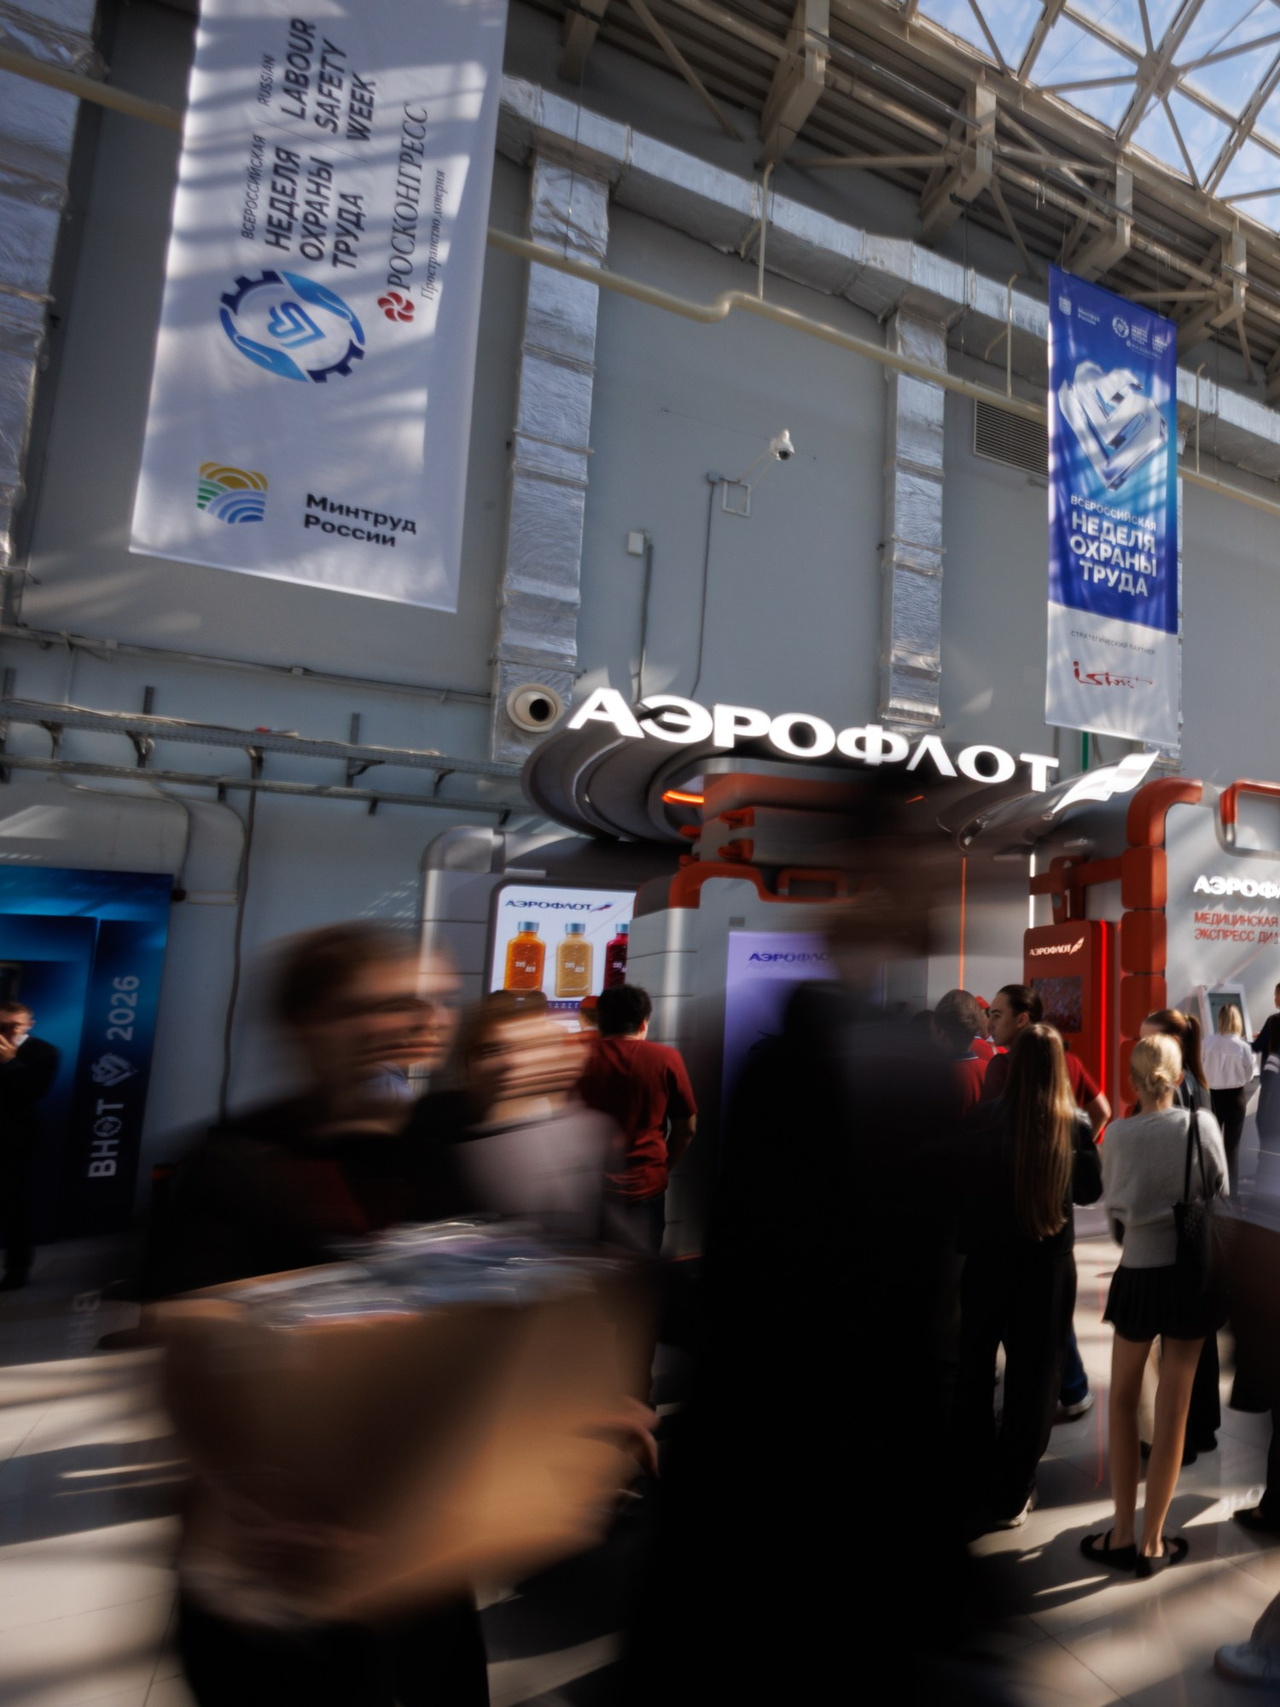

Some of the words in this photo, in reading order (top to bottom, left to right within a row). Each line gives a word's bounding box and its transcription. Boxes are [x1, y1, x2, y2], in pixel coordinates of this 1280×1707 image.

[257, 51, 276, 107] RUSSIAN
[281, 18, 316, 120] LABOUR
[314, 37, 347, 134] SAFETY
[346, 71, 376, 141] WEEK
[241, 133, 266, 240] ВСЕРОССИЙСКАЯ
[264, 146, 301, 252] НЕДЕЛЯ
[299, 155, 334, 262] ОХРАНЫ
[387, 100, 428, 291] РОСКОНГРЕСС
[331, 192, 367, 269] ТРУДА
[421, 216, 443, 301] Пространство
[304, 513, 396, 547] России
[306, 493, 417, 535] Минтруд
[1071, 495, 1157, 531] ВСЕРОССИЙСКАЯ
[1072, 511, 1155, 554] НЕДЕЛЯ
[1070, 535, 1157, 578] ОХРАНЫ
[1079, 559, 1148, 597] ТРУДА
[566, 687, 1060, 792] АЭРОФЛОТ
[505, 900, 593, 911] АЭРОФЛОТ
[1194, 911, 1279, 927] МЕДИЦИНСКАЯ
[749, 952, 832, 962] АЭРОФЛО
[1029, 944, 1071, 956] АЭРОФЛОТ
[1194, 927, 1255, 942] ЭКСПРЕСС
[106, 975, 139, 1041] 2026
